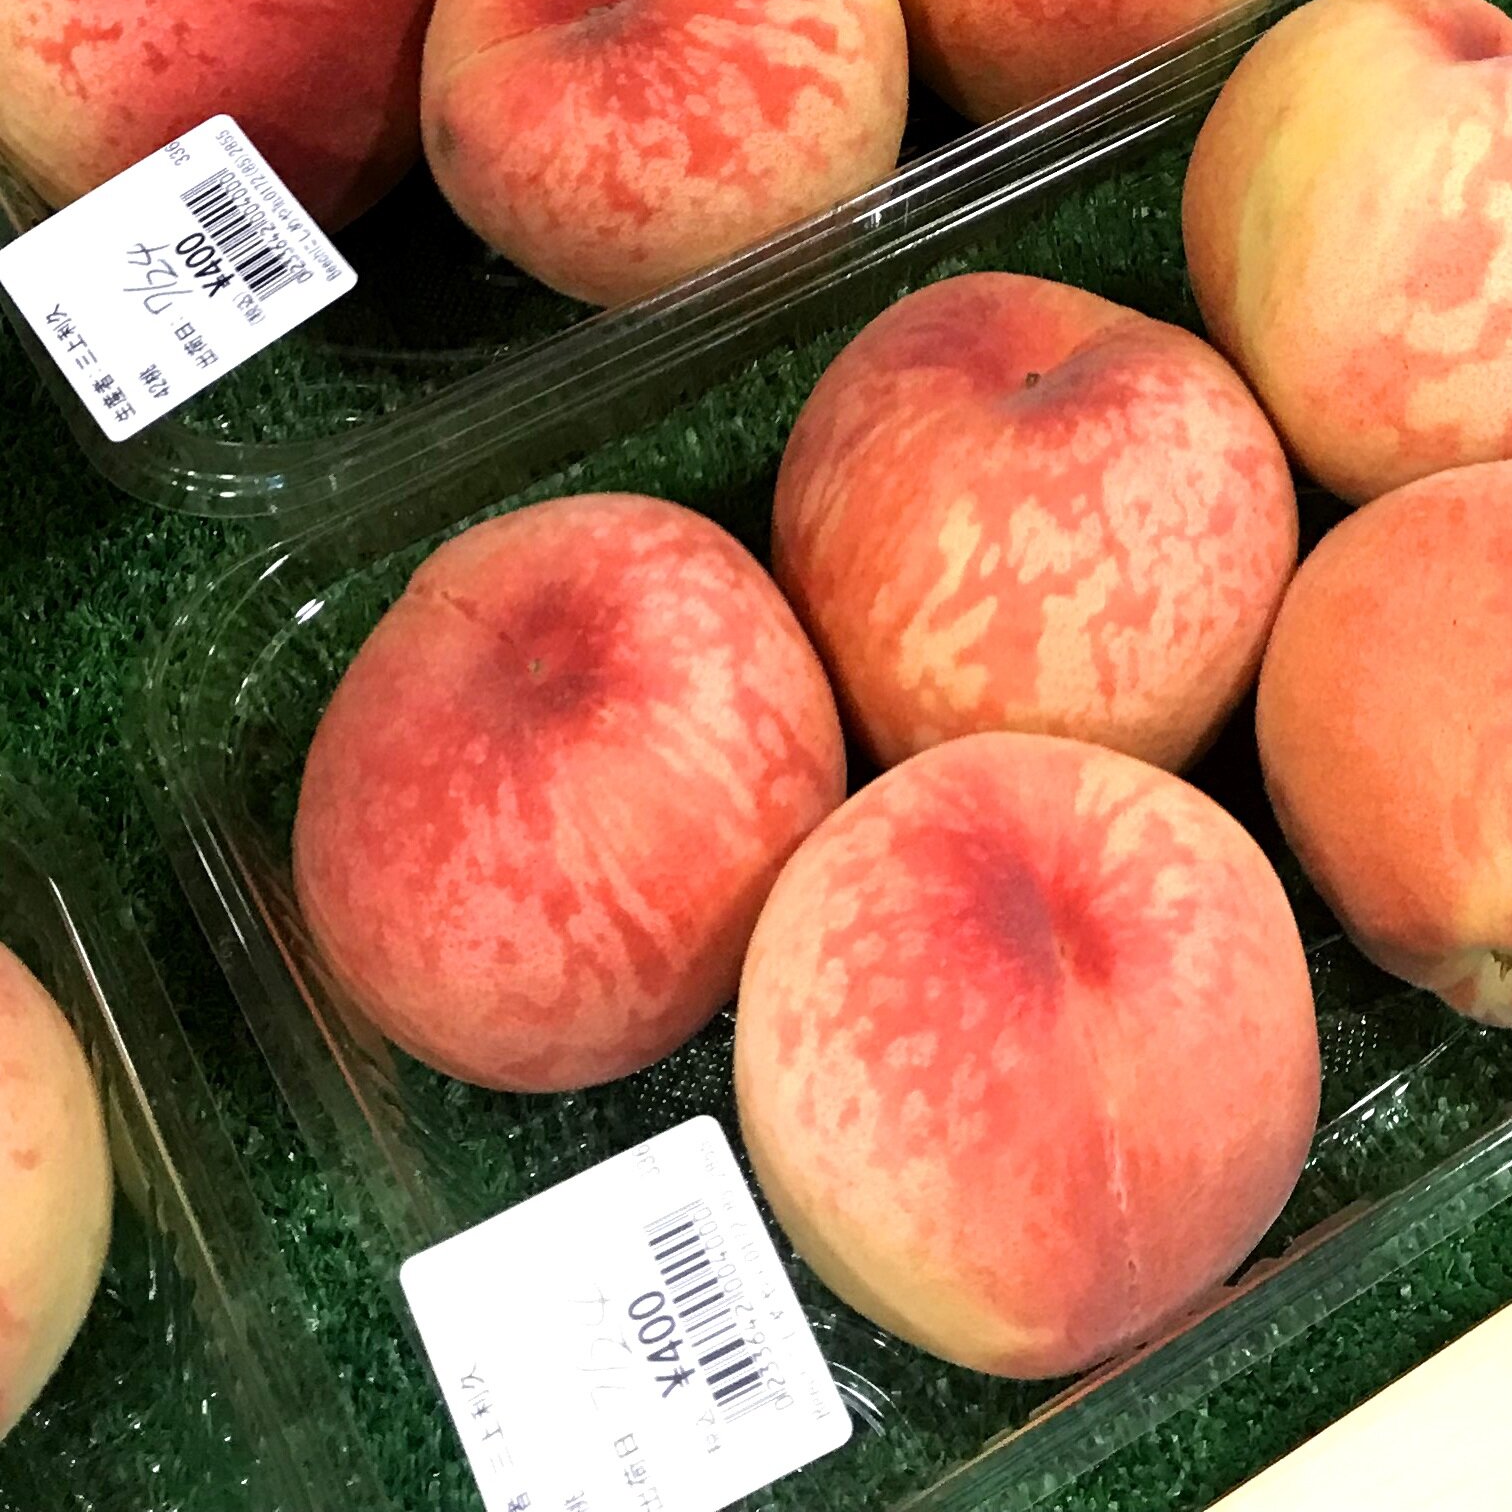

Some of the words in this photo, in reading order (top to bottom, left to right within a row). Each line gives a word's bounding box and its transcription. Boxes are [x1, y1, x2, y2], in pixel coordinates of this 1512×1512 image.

[122, 241, 193, 316] 7/24
[174, 231, 235, 298] ¥400
[627, 1289, 696, 1398] ¥400
